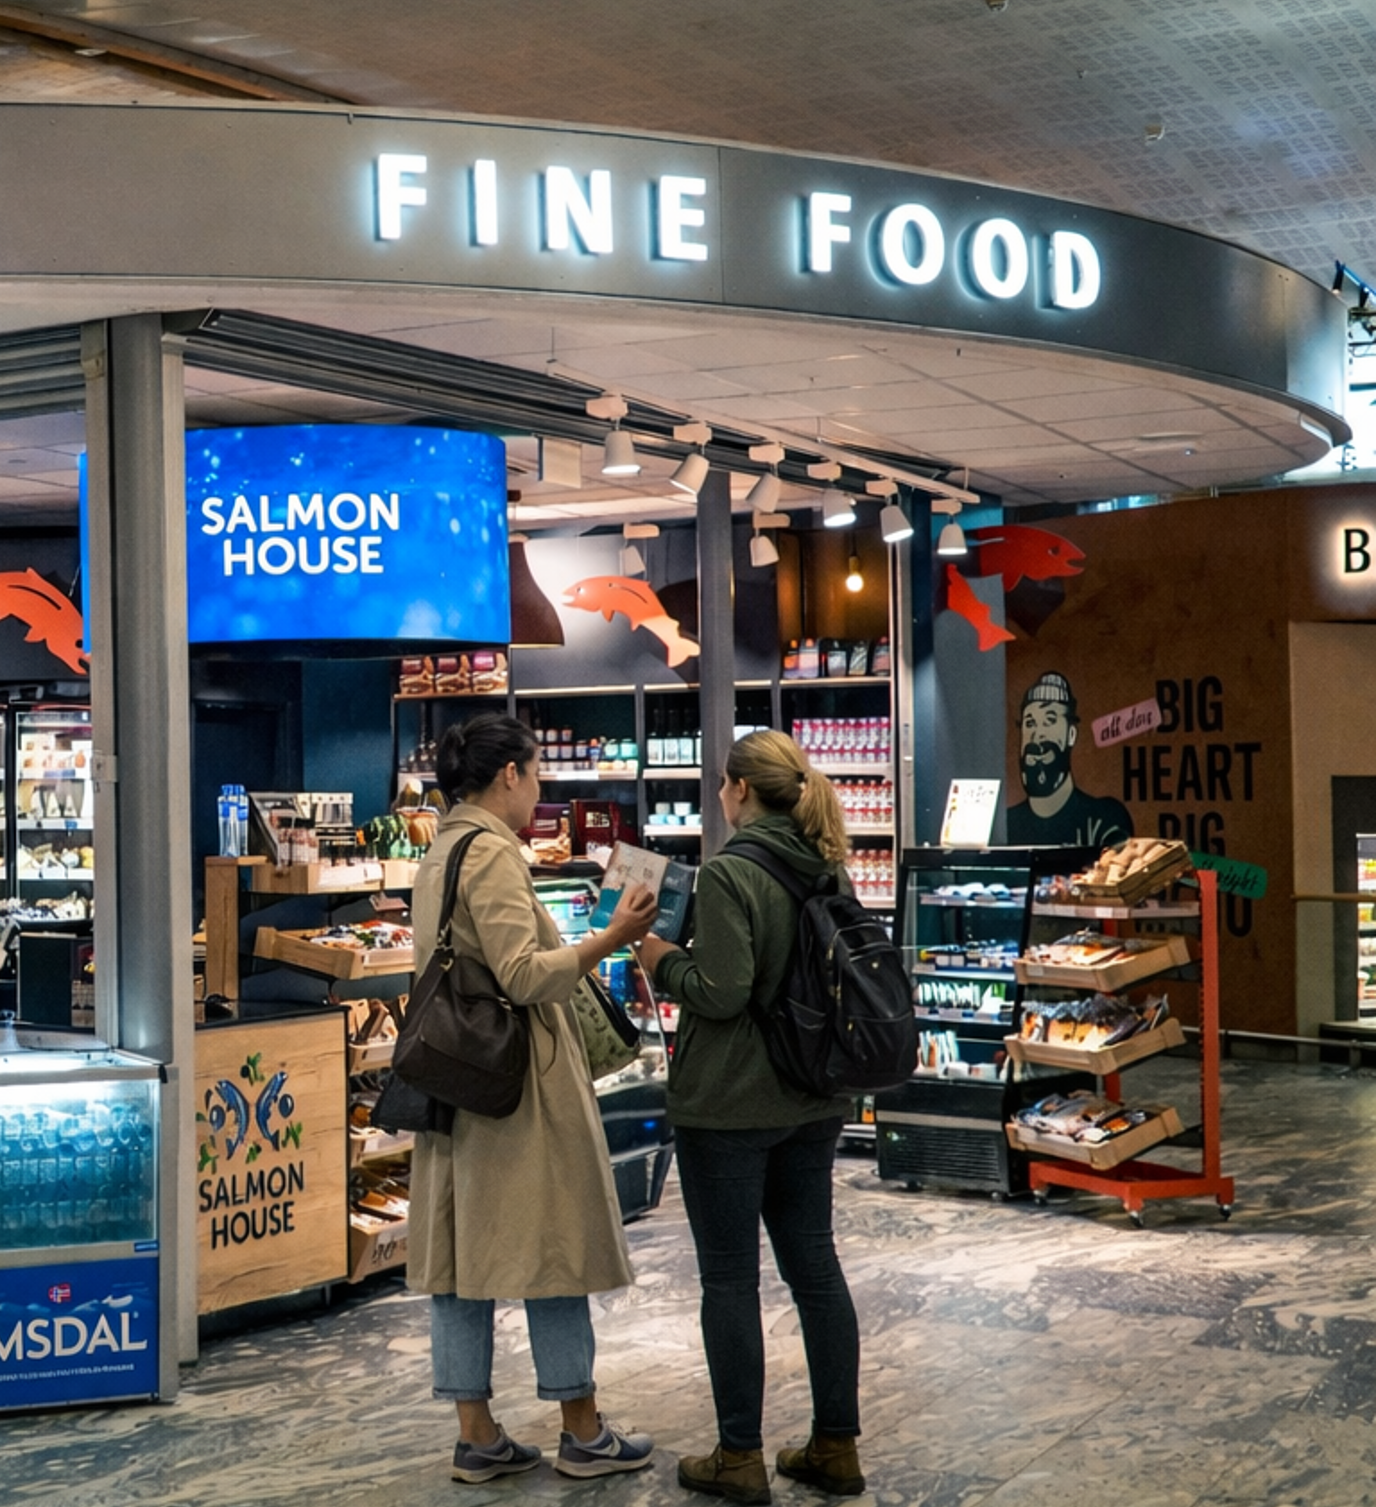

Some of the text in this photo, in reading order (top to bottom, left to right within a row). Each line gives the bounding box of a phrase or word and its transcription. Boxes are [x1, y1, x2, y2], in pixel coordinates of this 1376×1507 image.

[375, 153, 1102, 311] FINE FOOD
[200, 492, 400, 536] SALMON
[224, 536, 385, 576] HOUSE
[1155, 675, 1223, 734] BIG
[1123, 742, 1262, 802] HEART
[198, 1160, 305, 1214] SALMON
[210, 1200, 296, 1250] HOUSE
